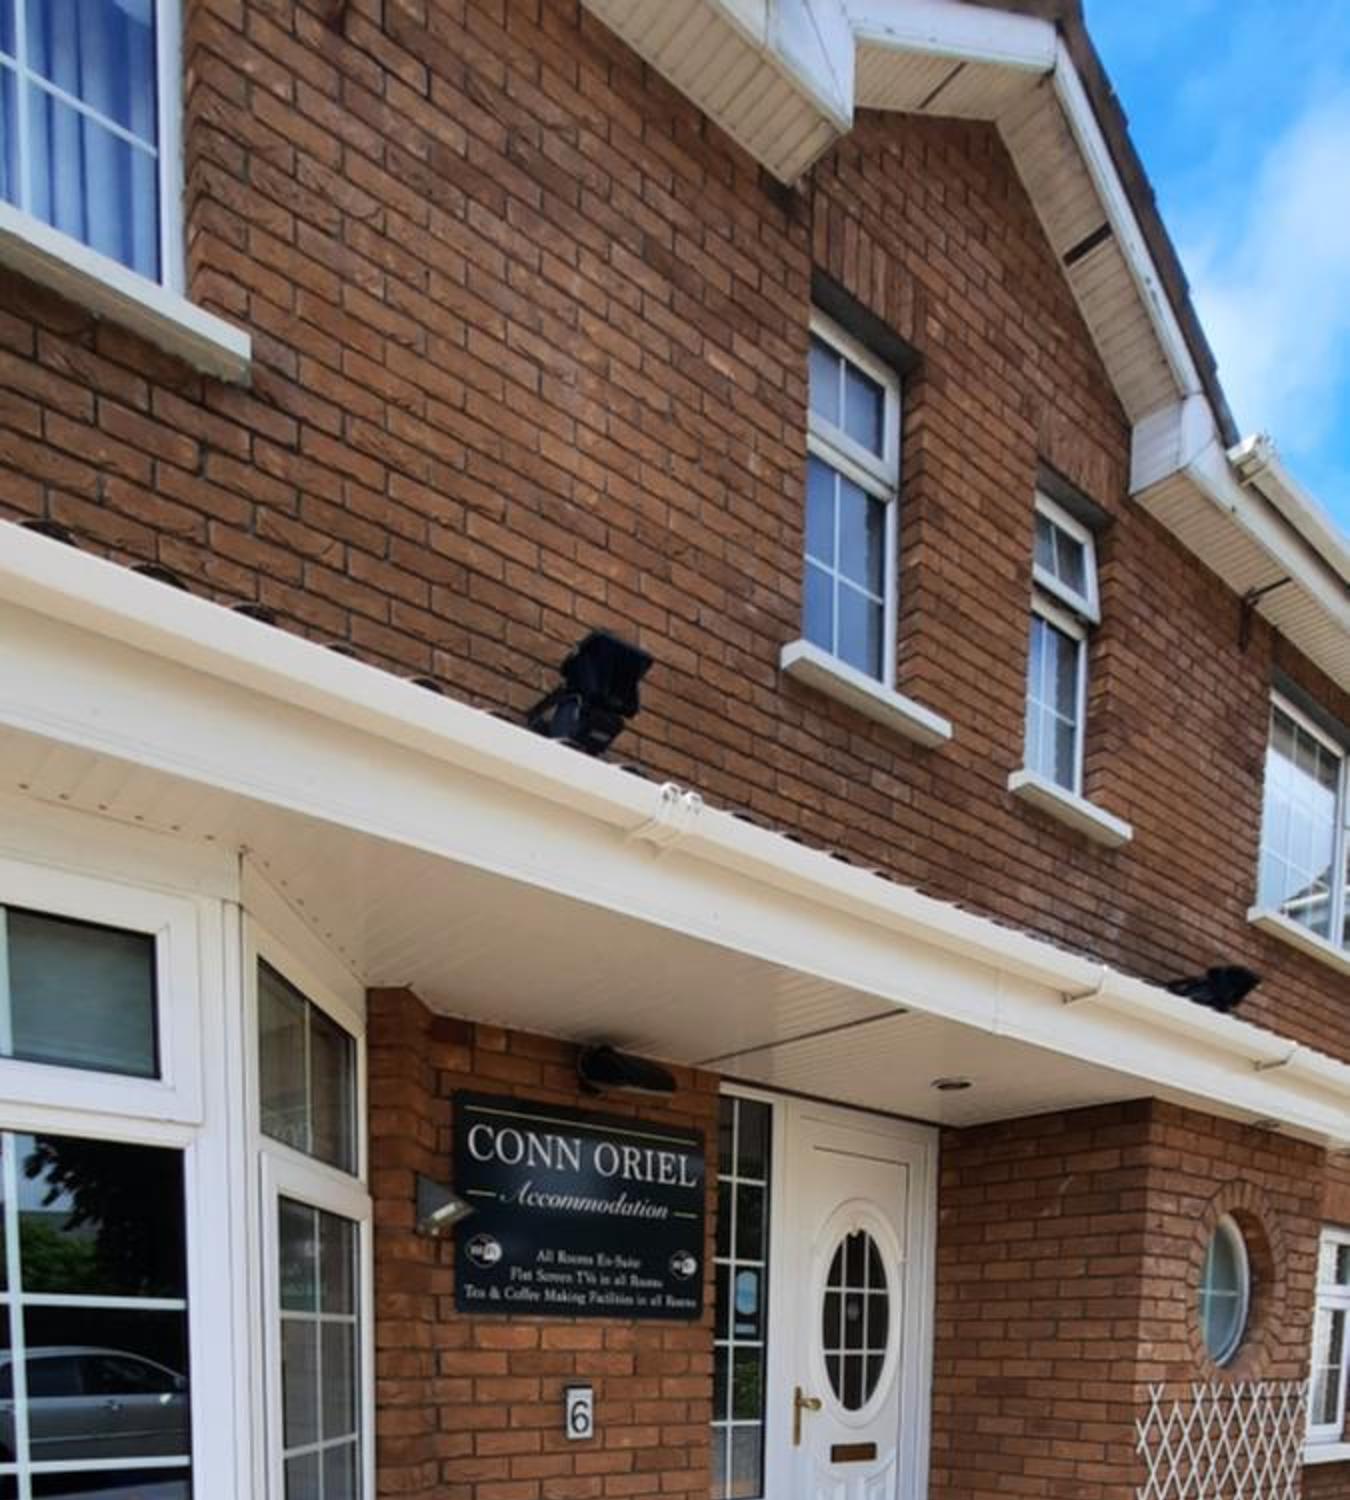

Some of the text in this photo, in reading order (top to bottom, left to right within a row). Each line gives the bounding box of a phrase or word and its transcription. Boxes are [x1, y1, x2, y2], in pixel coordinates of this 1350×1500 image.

[467, 1124, 697, 1188] CONN ORIEL
[501, 1181, 668, 1219] Accommodation
[536, 1249, 555, 1263] All
[557, 1250, 593, 1265] Rooms
[464, 1283, 486, 1299] Tea
[488, 1286, 500, 1299] &
[503, 1286, 540, 1302] Coffee
[543, 1288, 586, 1305] Making
[571, 1400, 589, 1433] 6
